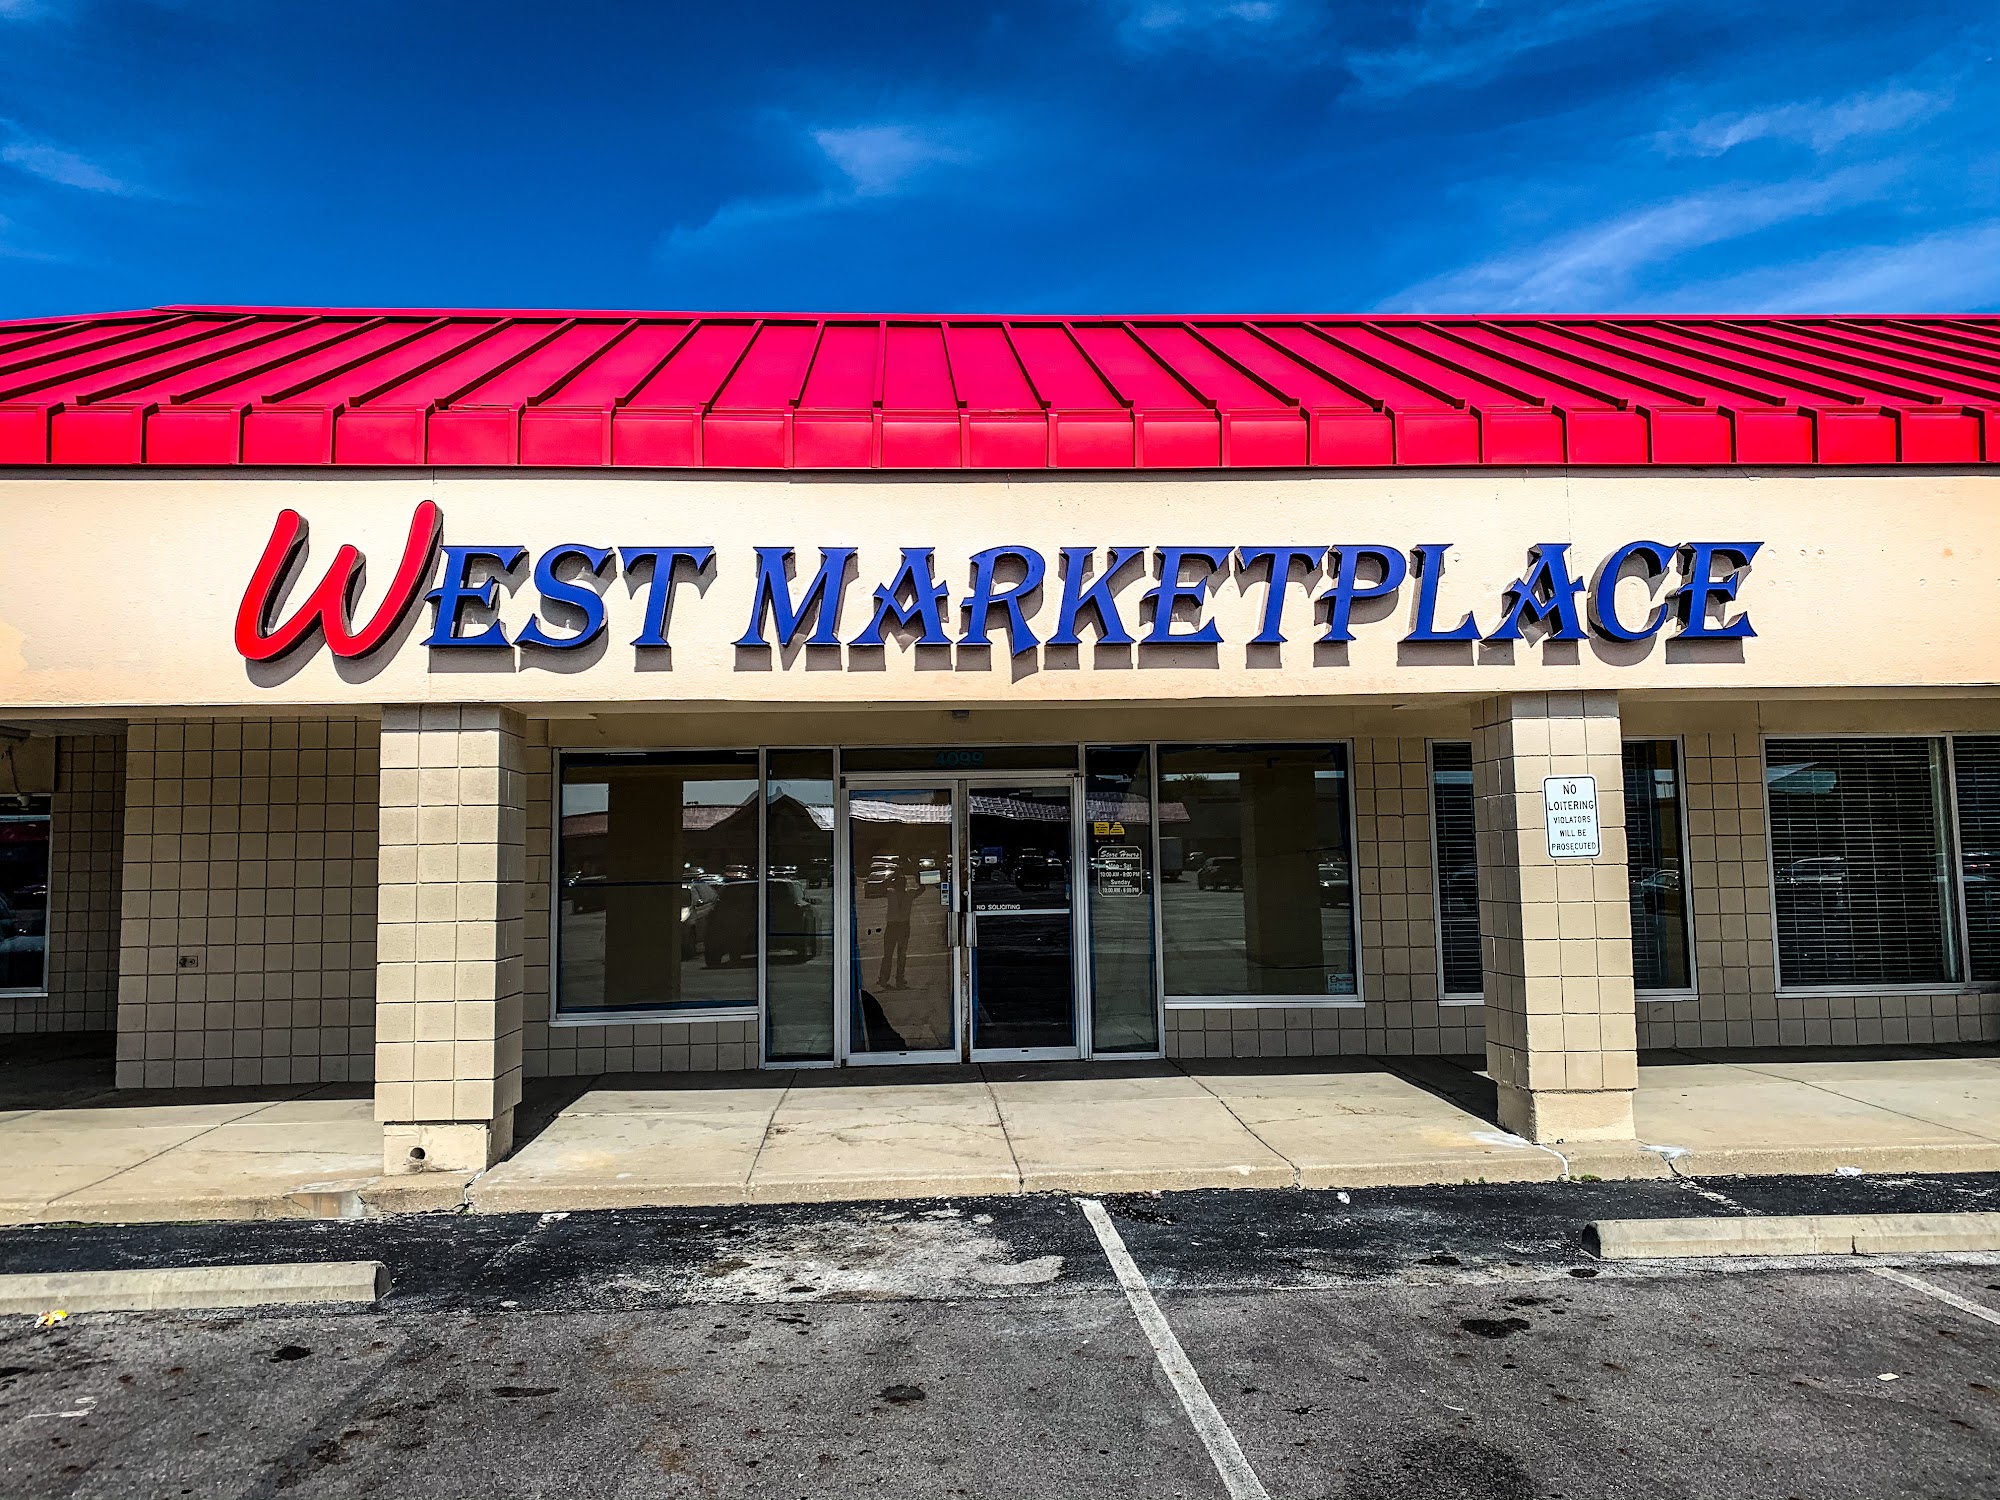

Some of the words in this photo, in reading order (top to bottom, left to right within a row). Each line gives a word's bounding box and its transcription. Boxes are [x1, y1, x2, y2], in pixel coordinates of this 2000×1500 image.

[234, 500, 715, 661] WEST
[730, 540, 1764, 659] MARKETPLACE
[936, 751, 983, 768] 4099
[1562, 784, 1577, 795] NO
[1548, 800, 1594, 811] LOITERING
[1553, 815, 1591, 824] VIOLATORS
[1559, 829, 1575, 837] WILL
[1577, 828, 1587, 837] BE
[1551, 841, 1597, 851] PROSECUTED
[1100, 850, 1118, 858] Store
[1118, 850, 1139, 858] Hours
